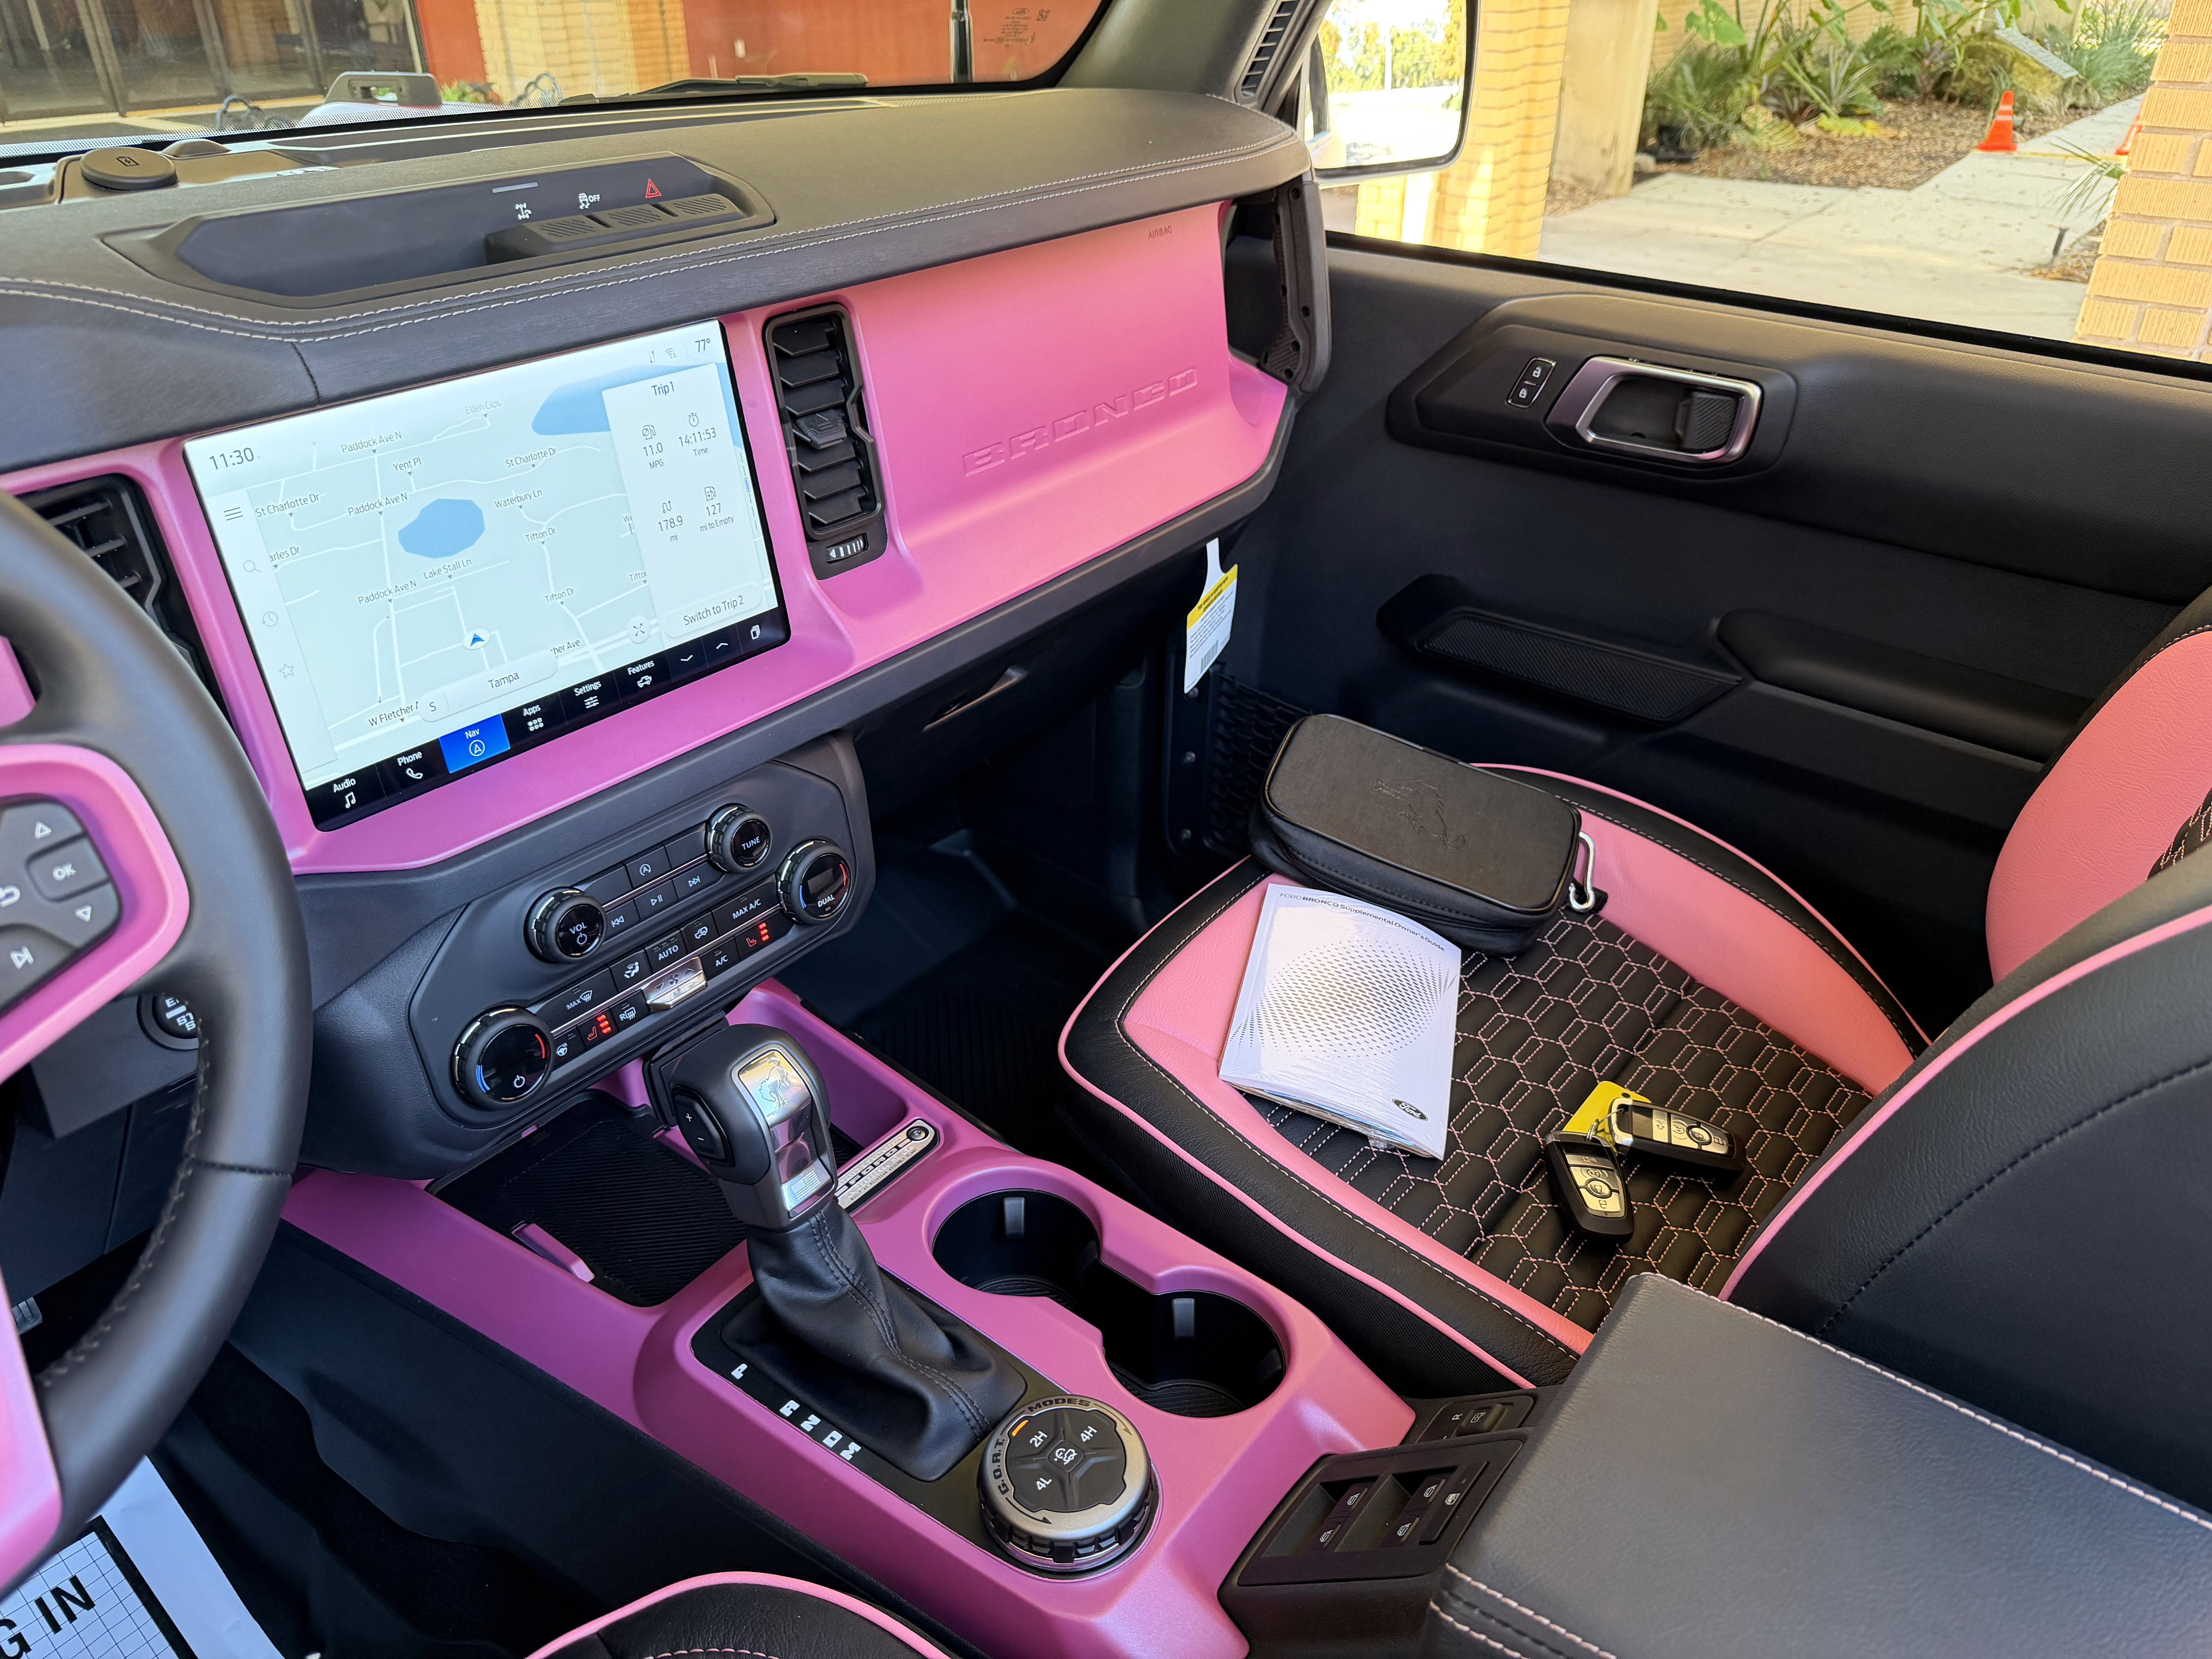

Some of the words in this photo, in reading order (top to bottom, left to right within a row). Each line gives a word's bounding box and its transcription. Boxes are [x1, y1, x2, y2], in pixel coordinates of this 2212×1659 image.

[588, 194, 601, 203] OFF
[652, 385, 669, 397] Trip
[671, 382, 675, 392] 1
[466, 404, 484, 414] Ellen
[963, 369, 1198, 477] BRONCO
[341, 437, 377, 453] Paddock
[380, 433, 393, 445] Ave
[395, 431, 402, 441] N
[678, 428, 717, 447] 14:11:53
[506, 459, 515, 468] St
[516, 450, 549, 465] Charlotte
[549, 447, 557, 457] Dr
[643, 443, 664, 457] 11.0
[693, 447, 709, 457] Time
[209, 448, 254, 470] 11:30
[393, 461, 411, 472] Yent
[649, 459, 665, 470] MPG
[255, 508, 266, 517] St
[267, 497, 308, 515] Charlotte
[309, 493, 319, 503] Dr
[348, 501, 383, 515] Paddock
[385, 496, 399, 507] Ave
[400, 493, 407, 502] N
[495, 493, 532, 509] Waterbury
[532, 489, 543, 498] Ln
[706, 503, 722, 515] 127
[658, 515, 684, 532] 178.9
[715, 516, 735, 529] Empty
[526, 531, 547, 543] Tifton
[546, 527, 556, 536] Dr
[670, 534, 678, 542] mi
[290, 546, 300, 556] Dr
[423, 569, 442, 579] Lake
[443, 562, 462, 574] Stall
[462, 558, 472, 567] Ln
[358, 587, 394, 605] Paddock
[395, 583, 409, 594] Ave
[410, 580, 417, 588] N
[544, 590, 566, 603] Tifton
[565, 587, 575, 596] Dr
[684, 606, 712, 625] Switch
[712, 605, 721, 614] to
[721, 600, 737, 613] Trip
[738, 595, 744, 605] 2
[566, 639, 581, 651] Ave
[627, 660, 655, 675] Features
[489, 672, 520, 691] Tampa
[574, 681, 601, 696] Settings
[368, 717, 378, 726] W
[378, 703, 414, 723] Fletcher
[429, 702, 436, 712] S
[523, 705, 541, 716] Apps
[465, 728, 479, 738] Nav
[397, 751, 422, 766] Phone
[333, 777, 356, 792] Audio
[740, 836, 761, 850] TUNE
[53, 864, 76, 880] OK
[732, 905, 748, 919] MAX
[747, 898, 761, 910] A/C
[817, 894, 835, 907] DUAL
[569, 922, 588, 935] VOL
[1302, 896, 1339, 907] BRONCO
[1340, 904, 1394, 925] Supplemental
[1394, 922, 1424, 939] Owner's
[1424, 937, 1445, 951] Guide
[658, 945, 679, 960] AUTO
[715, 954, 729, 967] A/C
[566, 997, 582, 1010] MAX
[620, 1012, 627, 1021] R
[1398, 1101, 1423, 1119] Ford
[849, 1148, 898, 1185] FORD
[850, 1190, 862, 1200] BUILT
[731, 1363, 747, 1379] P
[780, 1400, 800, 1417] R
[800, 1414, 821, 1432] N
[823, 1431, 843, 1448] D
[1030, 1431, 1048, 1448] 2H
[1080, 1426, 1097, 1442] 4H
[840, 1442, 861, 1460] M
[992, 1438, 1009, 1495] G.O.A.T.
[1028, 1398, 1091, 1413] MODES
[1036, 1478, 1052, 1490] 4L
[34, 1575, 95, 1635] IN
